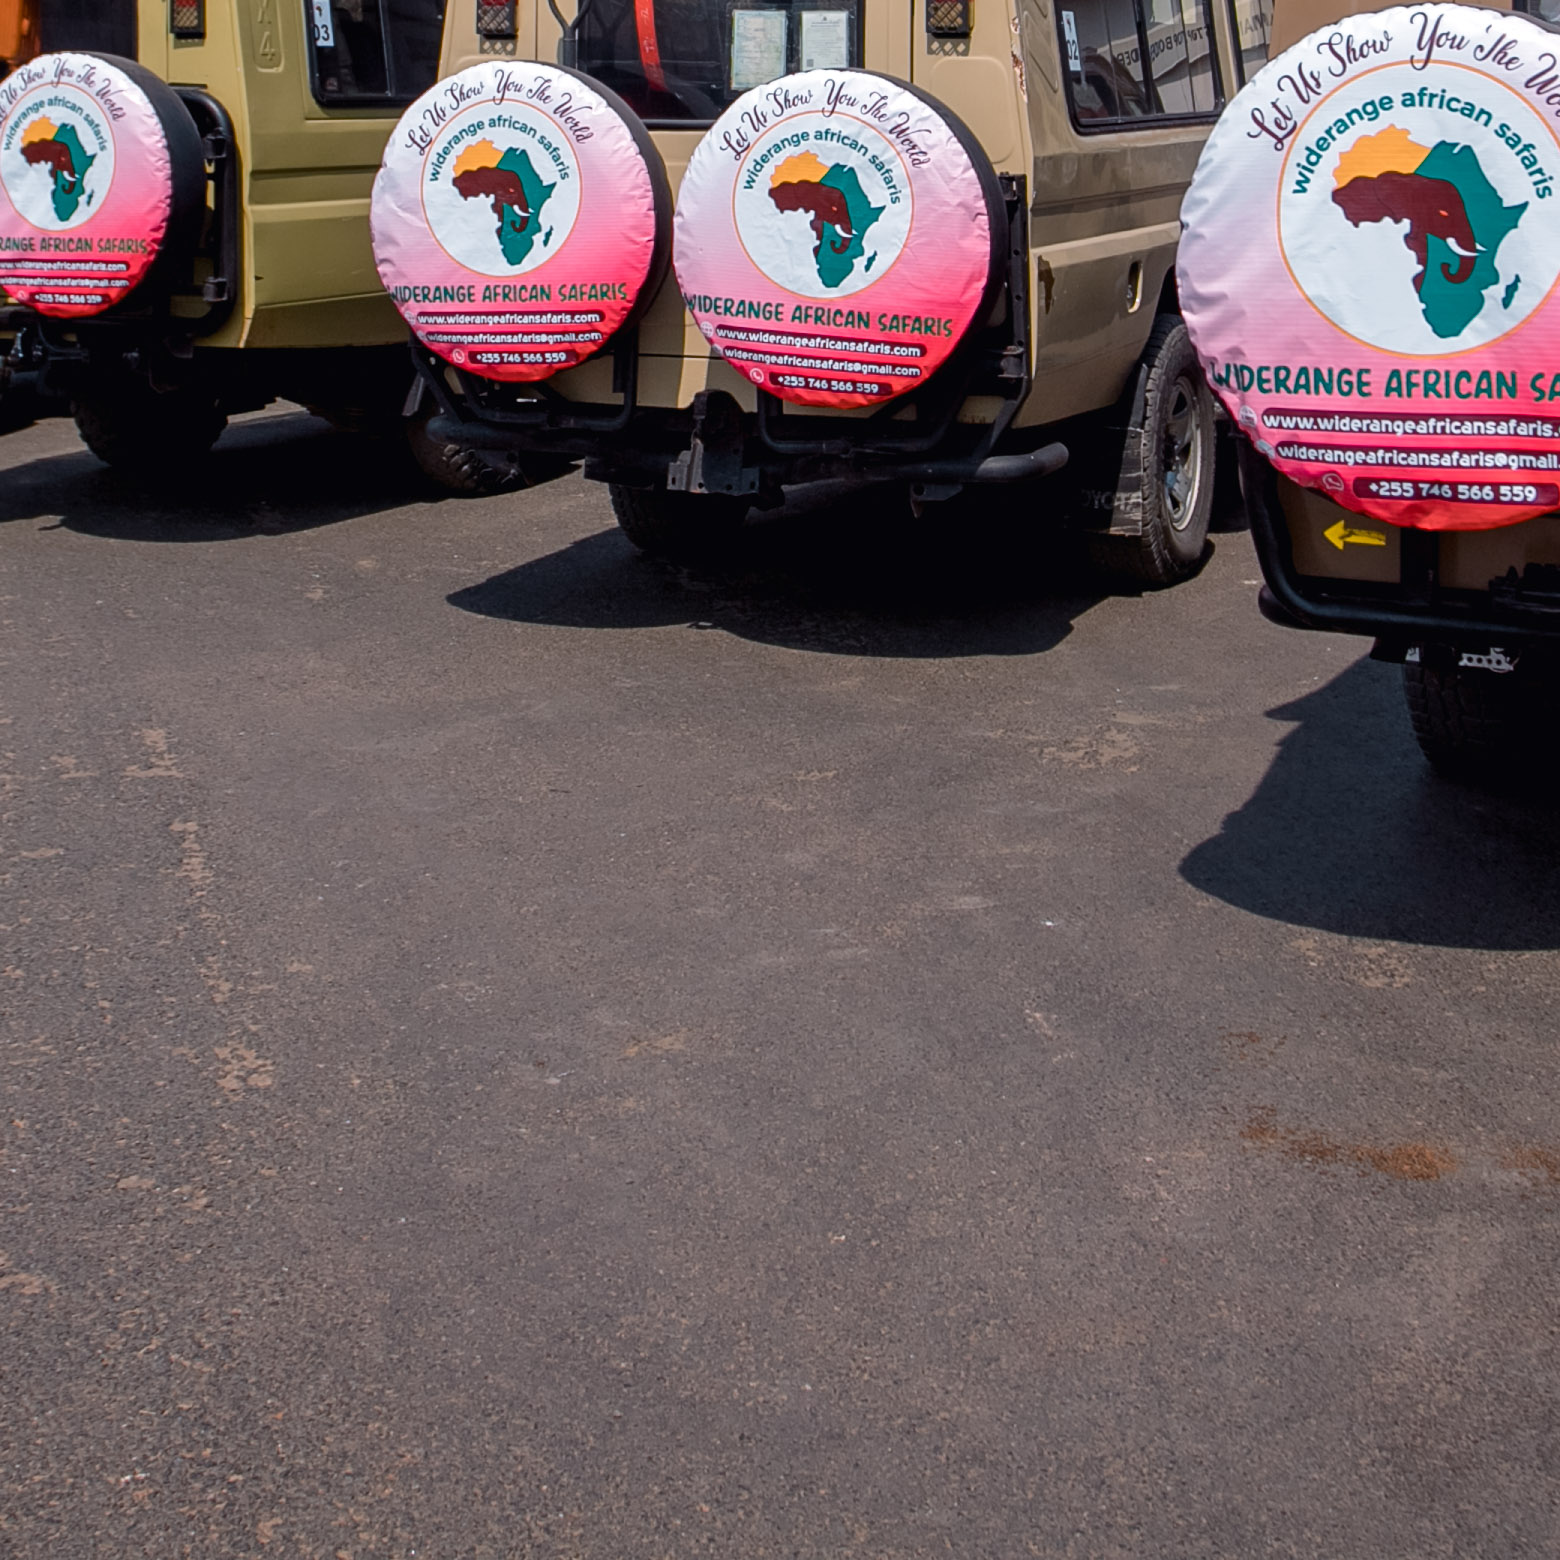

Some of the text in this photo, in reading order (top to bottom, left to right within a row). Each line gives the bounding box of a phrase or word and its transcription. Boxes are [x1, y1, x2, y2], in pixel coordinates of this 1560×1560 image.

[1247, 99, 1299, 151] Let
[1278, 63, 1321, 105] Us
[1317, 30, 1393, 77] Show
[1409, 12, 1469, 71] You
[1473, 25, 1524, 74] The
[4, 96, 107, 152] widerange african safaris
[405, 69, 595, 156] Let Us Show You The World
[720, 79, 931, 169] Let Us Show You The World
[429, 115, 568, 182] widerange african safaris
[1293, 86, 1552, 200] widerange african safaris
[744, 128, 901, 205] widerange african safaris
[40, 237, 93, 252] AFRICAN
[97, 238, 147, 254] SAFARIS
[482, 284, 552, 302] AFRICAN
[559, 282, 627, 302] SAFARIS
[418, 312, 600, 326] www.widerangeafricansafaris.com
[791, 305, 870, 330] AFRICAN
[878, 313, 952, 337] SAFARIS
[717, 327, 920, 357] www.widerangeafricansafaris.com
[725, 348, 920, 376] widerangeafricansafaris@gmail.com
[778, 375, 879, 394] +255 746 566 559
[1211, 363, 1371, 398] WIDERANGE
[1385, 369, 1517, 400] AFRICAN
[1369, 481, 1536, 503] +255 746 566 559
